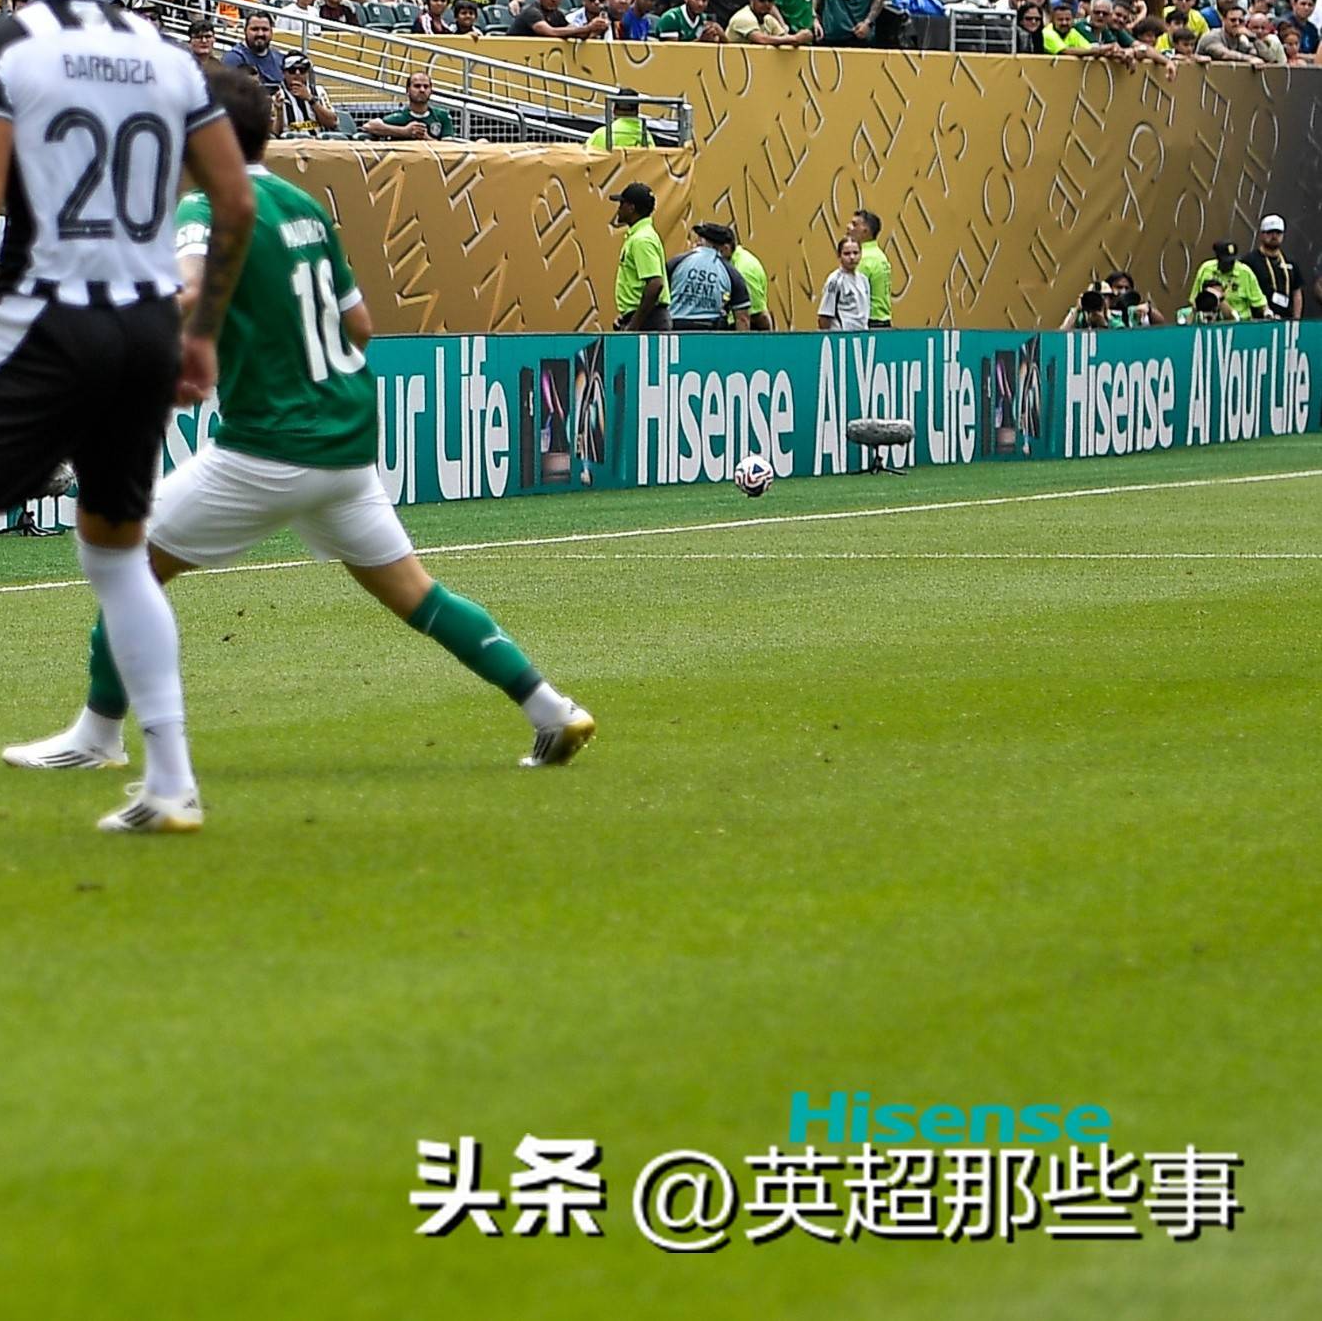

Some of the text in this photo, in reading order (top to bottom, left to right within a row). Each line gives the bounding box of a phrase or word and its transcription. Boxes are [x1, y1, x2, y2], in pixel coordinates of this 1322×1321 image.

[61, 53, 156, 85] BARBOZA
[43, 105, 178, 245] 20
[290, 258, 368, 384] 18
[687, 268, 718, 284] CSC
[377, 373, 426, 507] ur
[434, 333, 510, 501] Life
[638, 330, 976, 486] Hisense AI Your Life
[1065, 320, 1310, 458] Hisense AI Your Life
